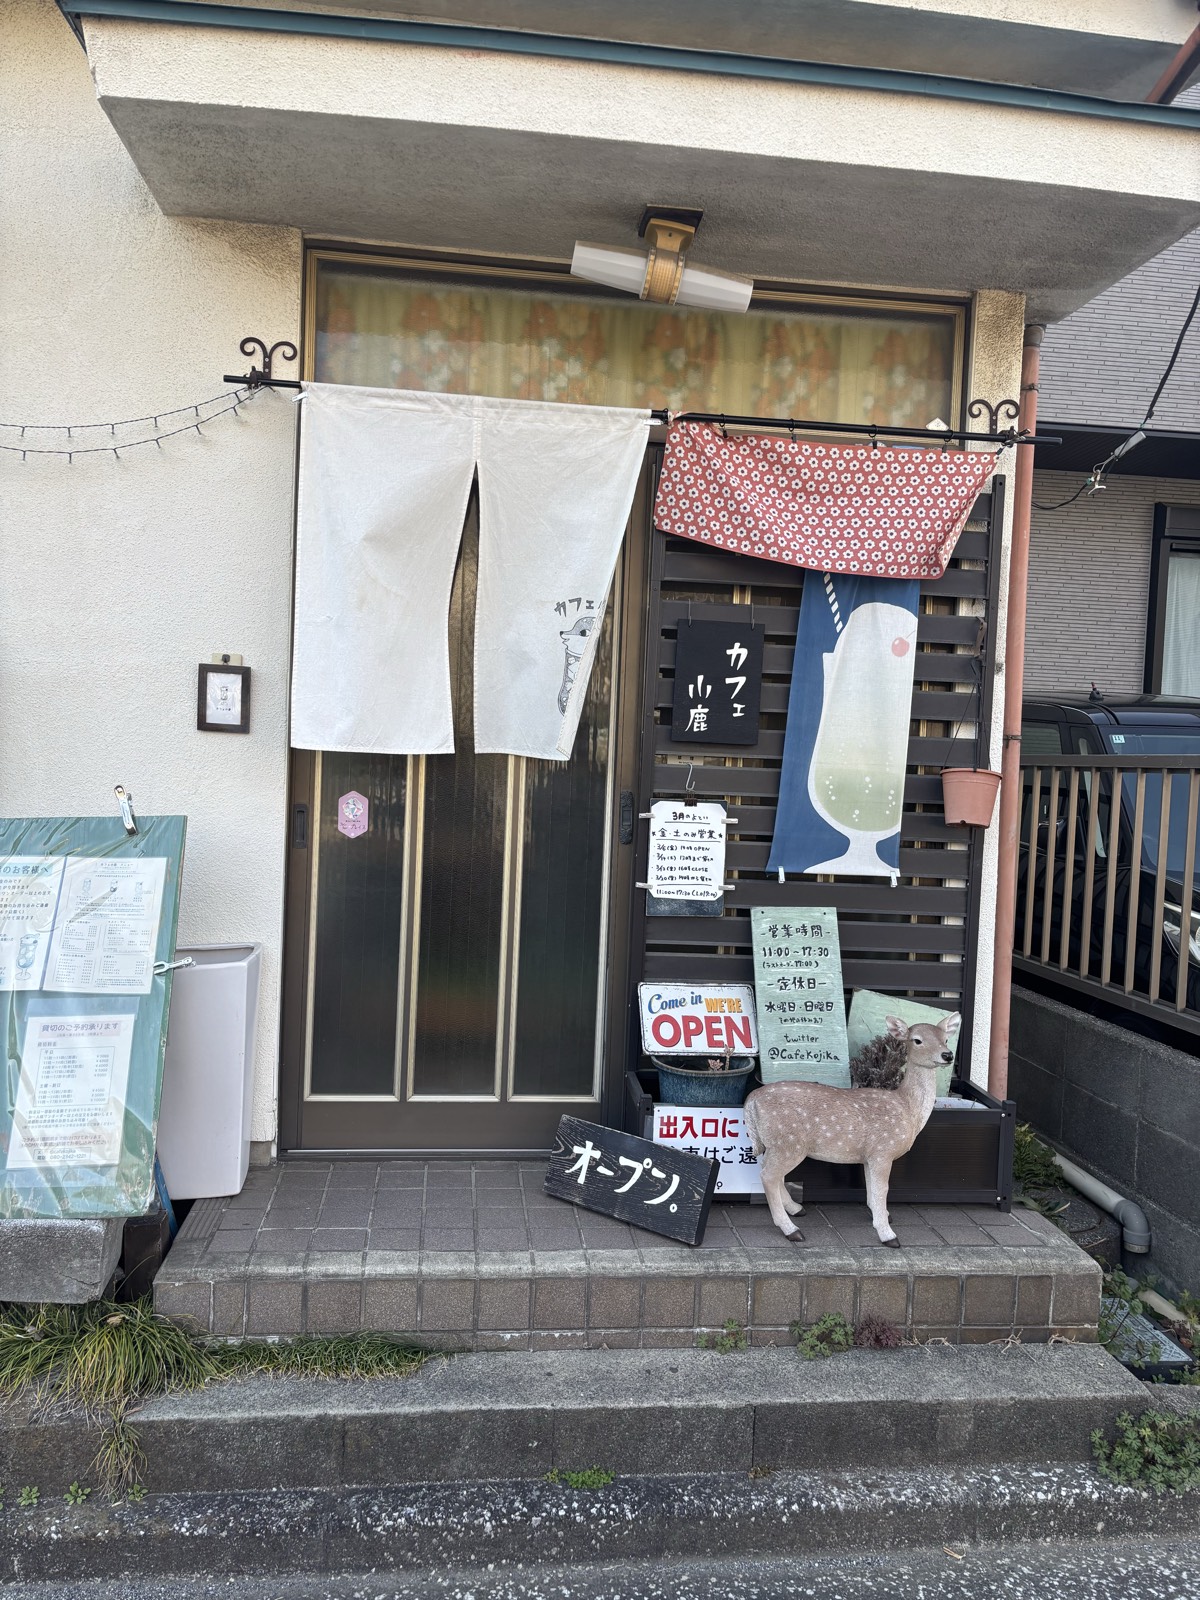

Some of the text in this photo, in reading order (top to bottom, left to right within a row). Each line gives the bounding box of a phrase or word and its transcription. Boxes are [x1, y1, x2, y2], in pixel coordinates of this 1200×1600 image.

[725, 642, 748, 717] カフェ
[685, 675, 712, 732] 小鹿
[648, 991, 743, 1014] Come in WE'RE
[765, 1001, 834, 1013] 水曜日・日曜日
[652, 1014, 753, 1048] OPEN
[784, 1033, 819, 1044] twitter
[659, 1115, 749, 1138] 出入口に
[565, 1140, 680, 1213] オープン。
